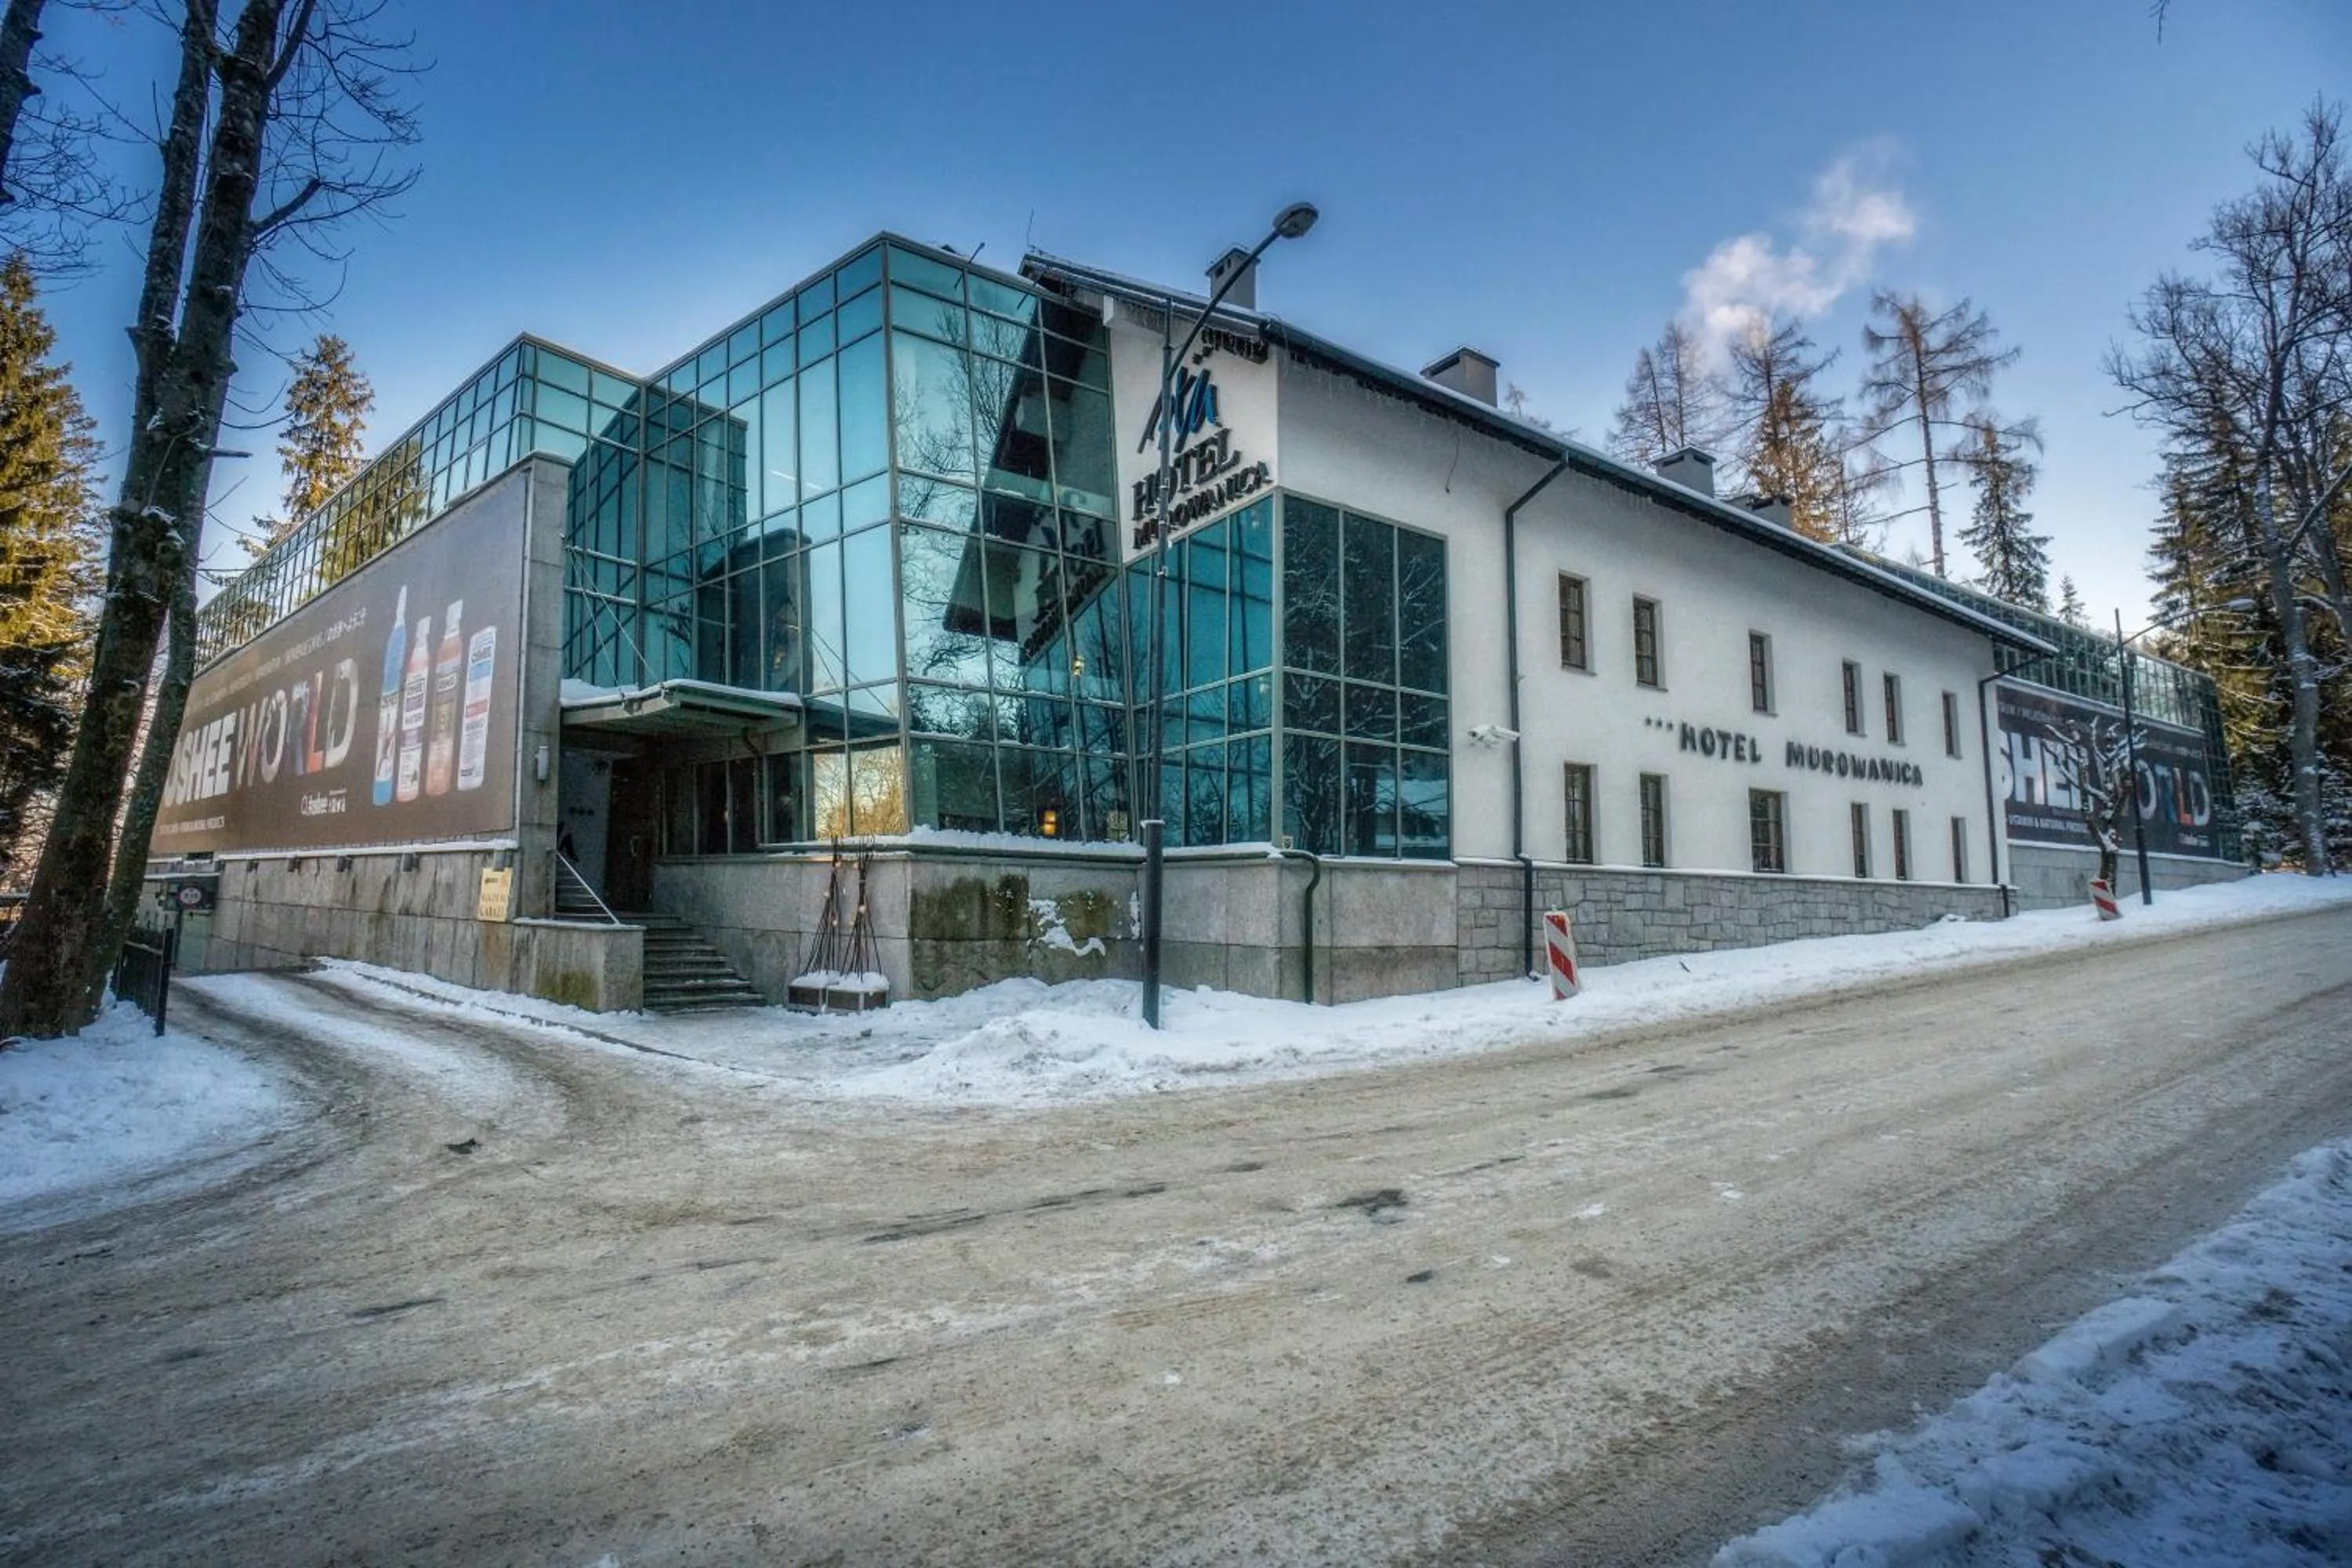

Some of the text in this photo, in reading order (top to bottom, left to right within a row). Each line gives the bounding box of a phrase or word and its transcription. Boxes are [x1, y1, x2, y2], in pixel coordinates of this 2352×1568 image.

[1131, 428, 1241, 521] HOTEL
[1679, 721, 1923, 786] HOTEL MUROWANICA
